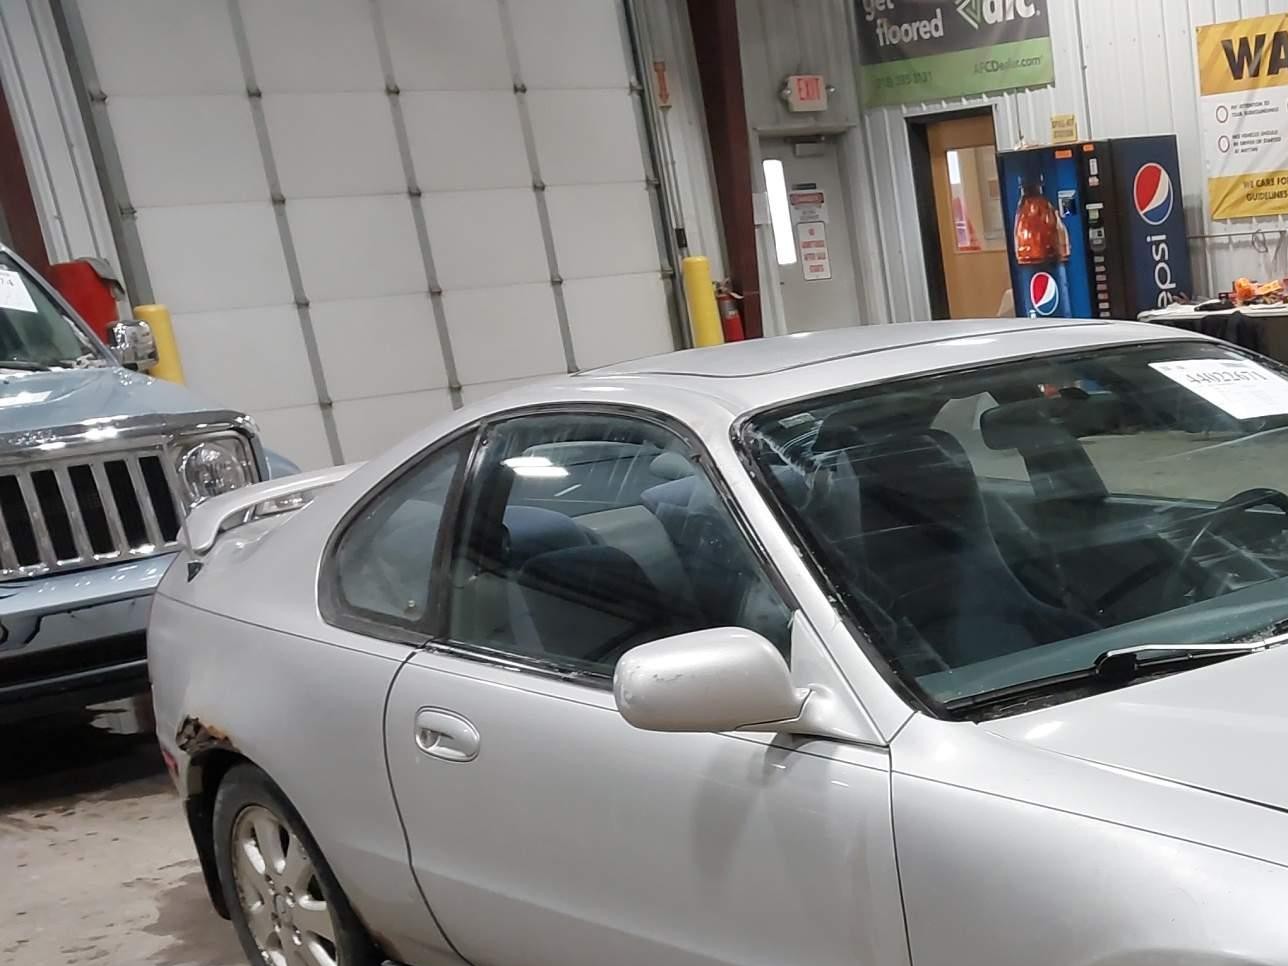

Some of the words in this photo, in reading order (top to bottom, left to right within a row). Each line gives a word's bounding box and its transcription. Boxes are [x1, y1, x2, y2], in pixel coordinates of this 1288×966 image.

[876, 8, 944, 46] floored
[797, 78, 820, 101] EXIT
[1255, 177, 1274, 188] CARE
[1246, 189, 1288, 201] GUIDELINES
[1147, 234, 1177, 309] epsi
